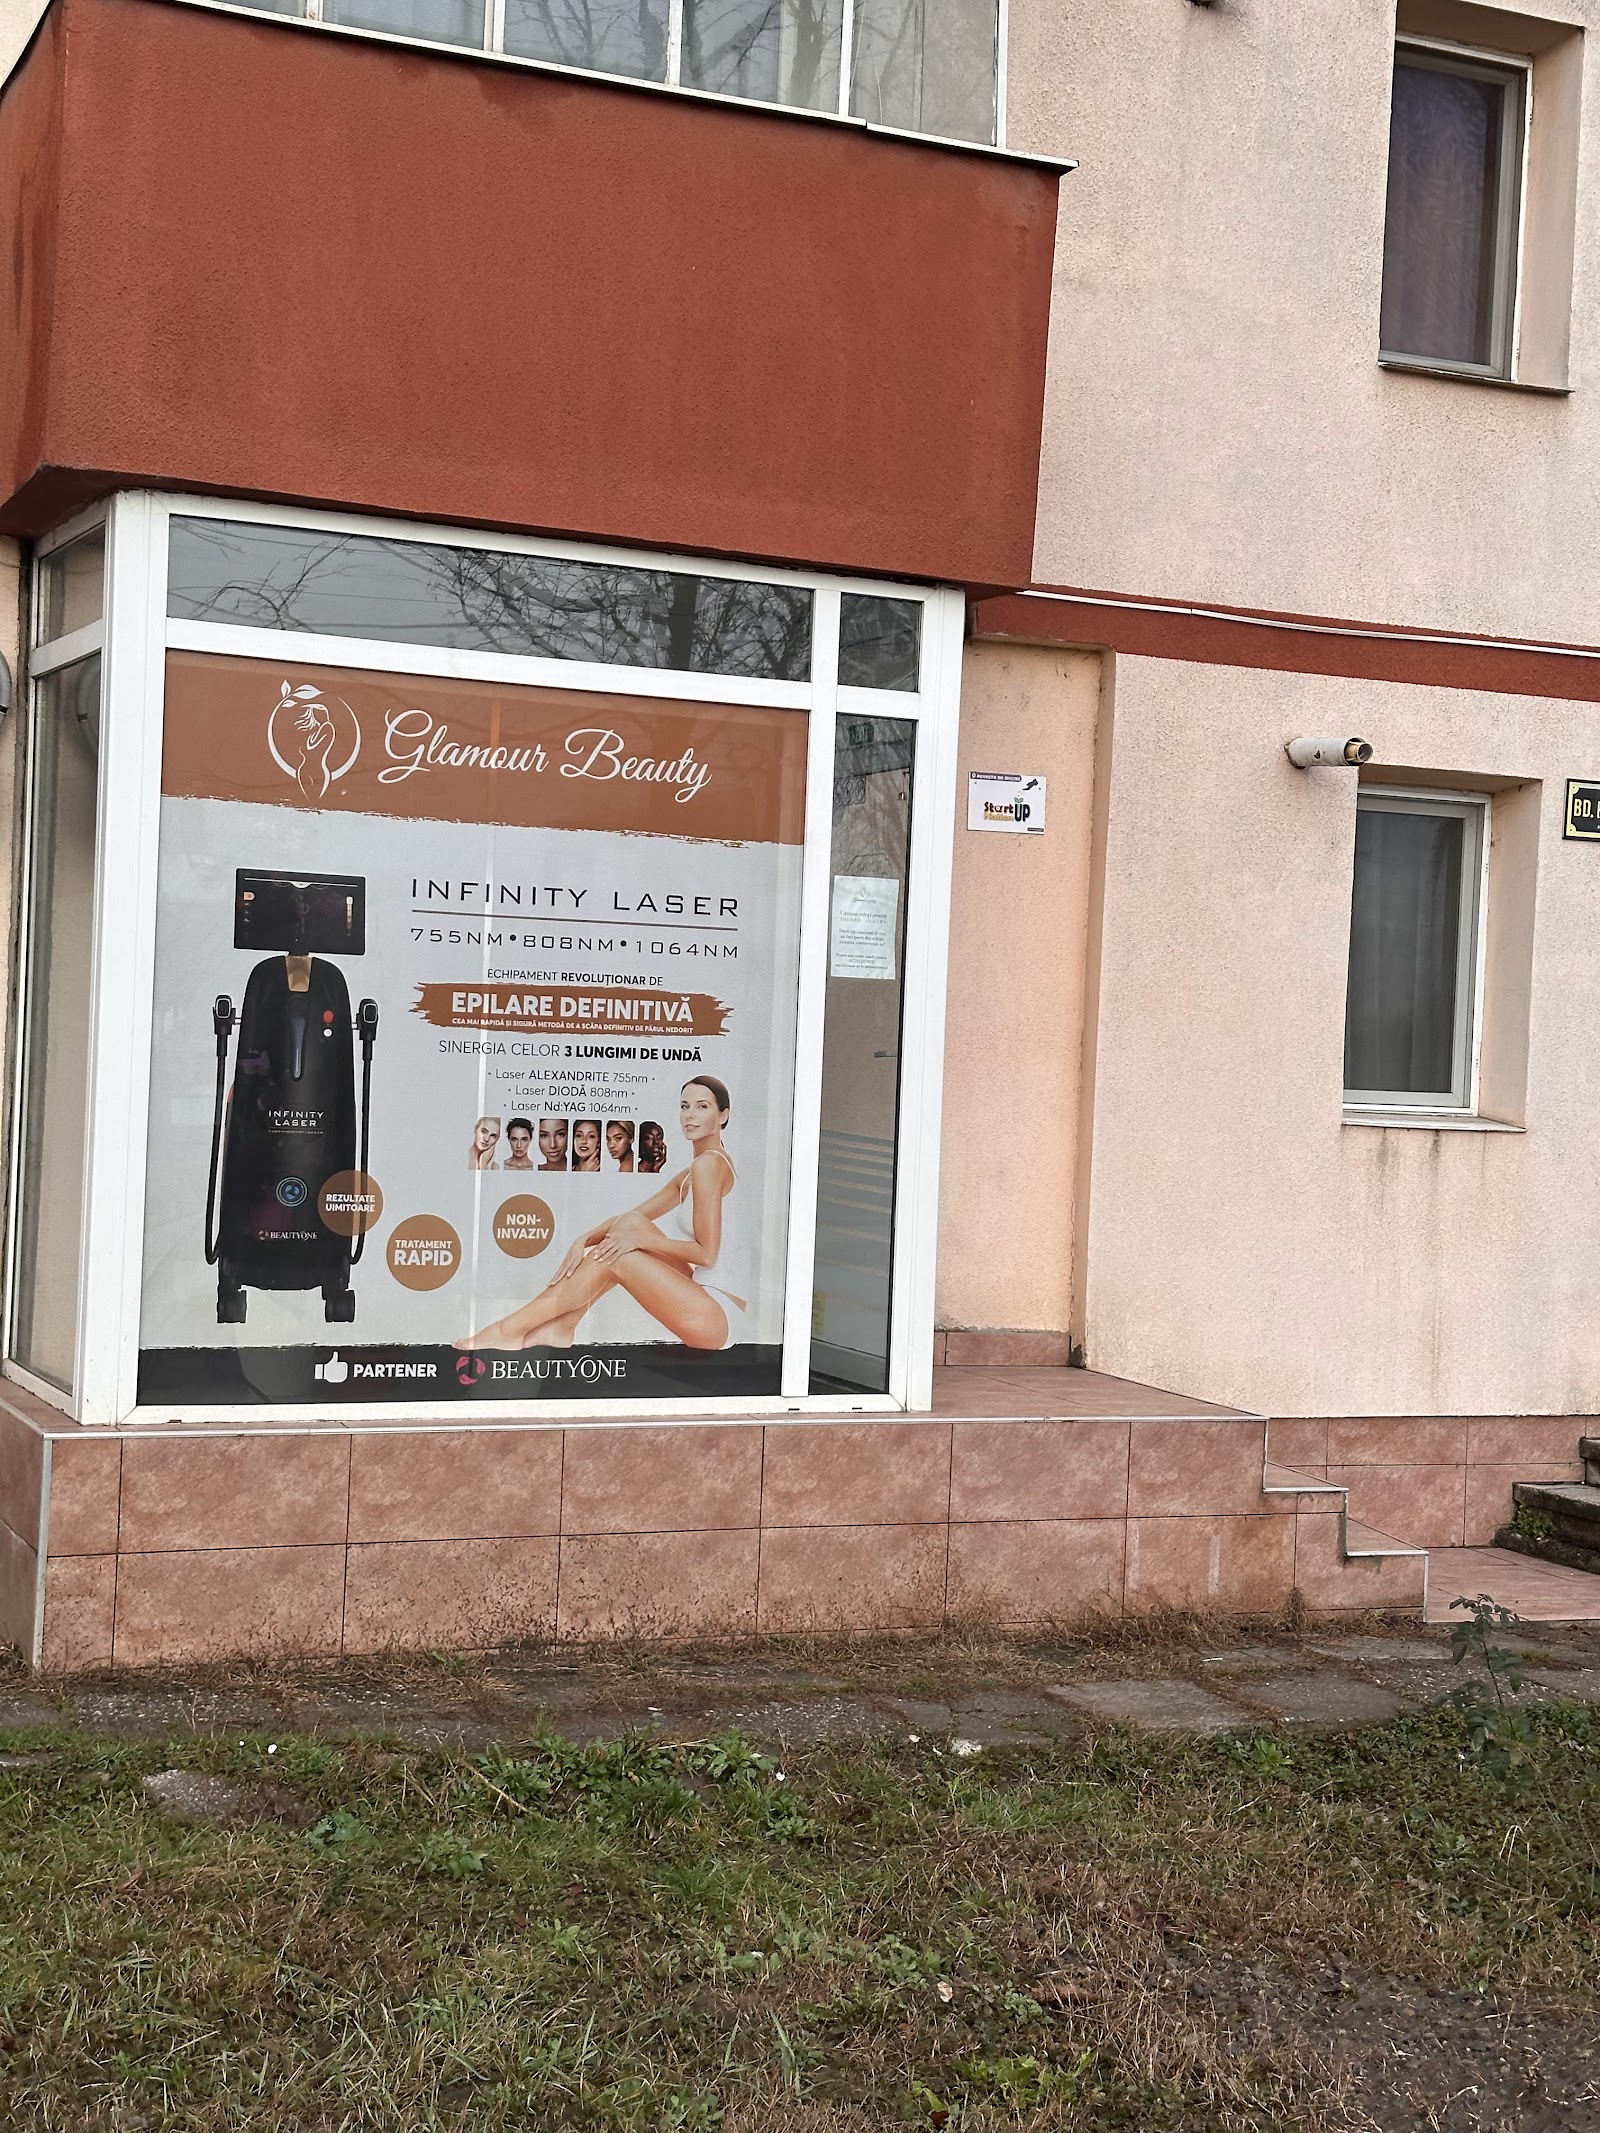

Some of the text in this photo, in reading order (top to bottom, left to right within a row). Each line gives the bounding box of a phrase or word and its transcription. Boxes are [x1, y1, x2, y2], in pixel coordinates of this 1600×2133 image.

[378, 708, 712, 803] Glamour Beauty
[1573, 798, 1595, 819] BD.
[412, 878, 738, 917] INFINITY LASER
[487, 968, 558, 981] ECHIPAMENT
[649, 976, 664, 986] DE
[452, 991, 694, 1023] EPILARE DEFINITIVĂ
[481, 1018, 505, 1026] RAPIDĂ
[438, 1039, 702, 1062] SINERGIA CELOR 3 LUNGIMI DE UNDĂ
[495, 1068, 648, 1083] Laser ALEXANDRITE 755nm
[515, 1084, 628, 1098] Laser DIODĂ 808nm
[511, 1099, 631, 1113] Laser Nd:YAG 1064nm
[268, 1110, 324, 1119] INFINITY
[275, 1118, 317, 1127] LASER
[325, 1193, 376, 1203] REZULTATE
[325, 1203, 376, 1212] UIMITOARE
[506, 1213, 542, 1226] NON-
[497, 1227, 550, 1240] INVAZIV
[394, 1239, 453, 1249] TRATAMENT
[393, 1249, 454, 1266] RAPID
[353, 1354, 627, 1383] PARTENER BEAUTYONE
